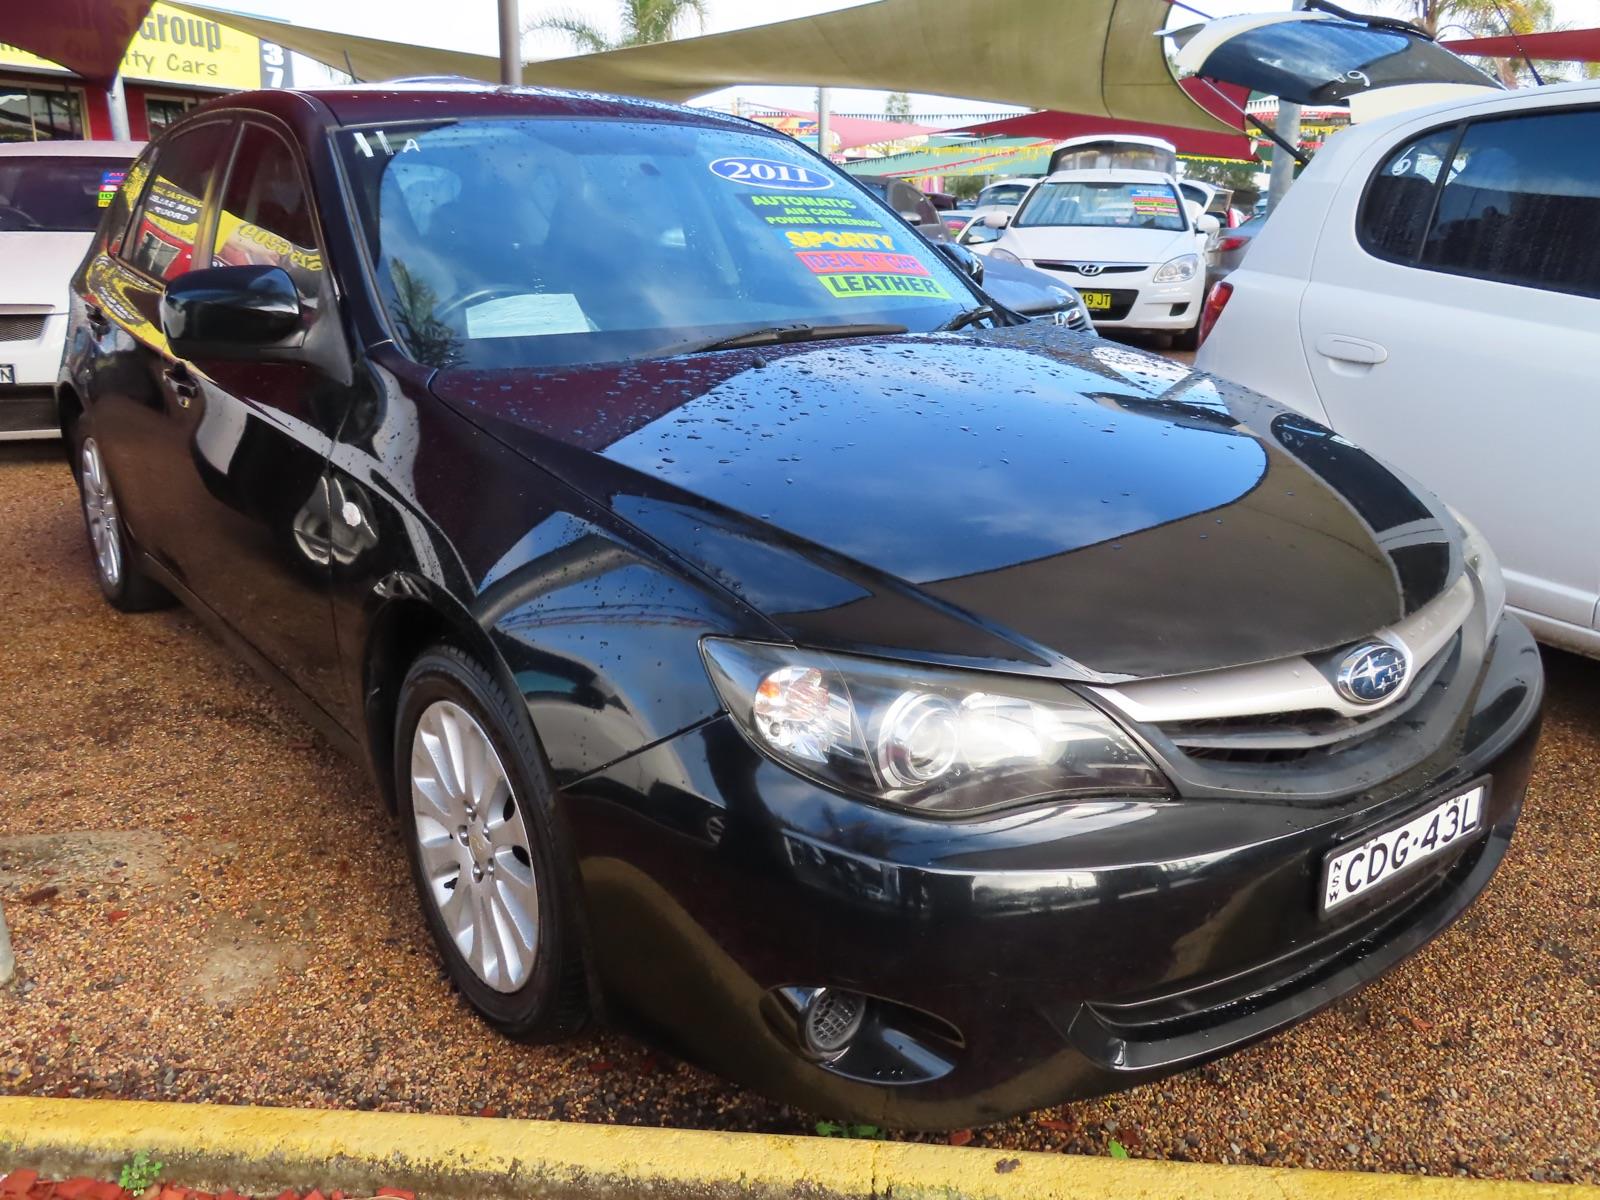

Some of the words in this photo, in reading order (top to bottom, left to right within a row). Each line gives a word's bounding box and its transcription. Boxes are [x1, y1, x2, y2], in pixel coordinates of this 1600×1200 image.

[139, 13, 222, 52] Group
[166, 53, 218, 76] Cars
[724, 162, 813, 184] 2011
[752, 195, 857, 209] AUTOMATIC
[785, 208, 810, 216] AIR
[810, 208, 852, 217] COND.
[766, 216, 818, 225] POWER
[818, 217, 883, 228] STEERING
[786, 231, 895, 250] SPORTY
[803, 254, 864, 269] IDEAL
[885, 255, 919, 269] CAR
[829, 276, 941, 294] LEATHER
[1329, 861, 1342, 902] NSW
